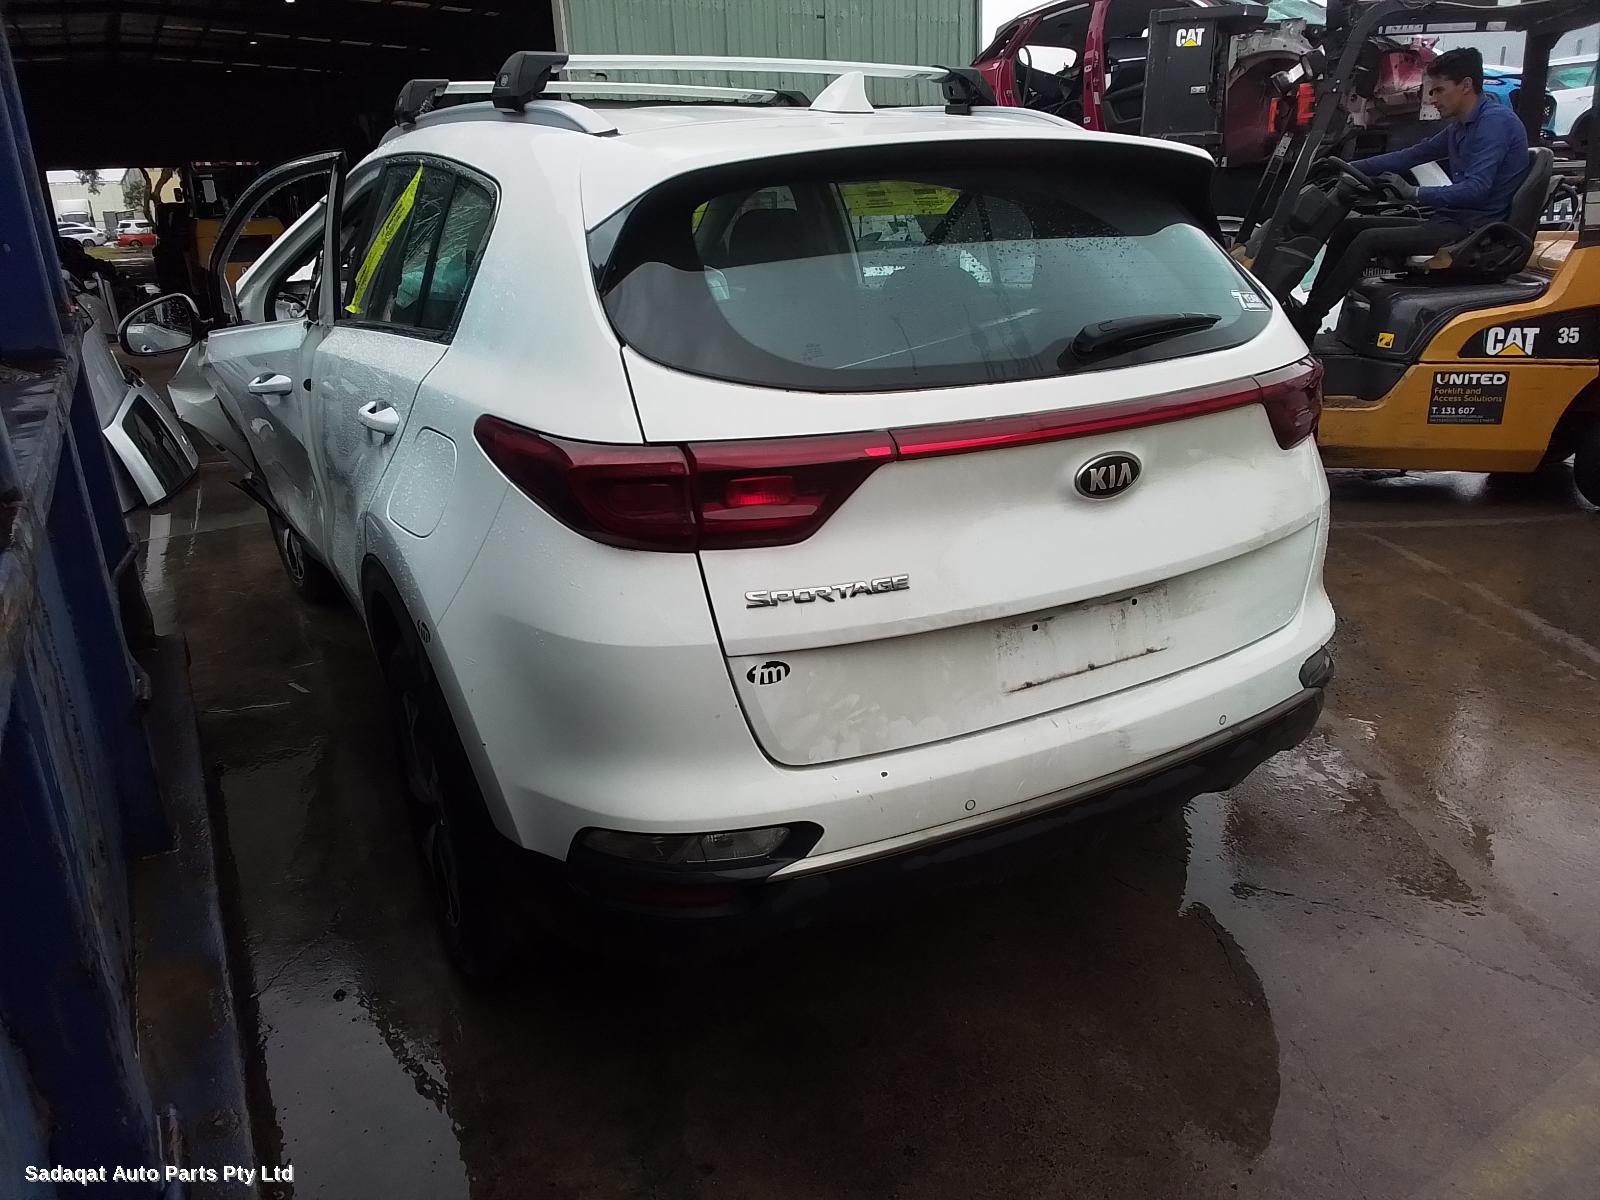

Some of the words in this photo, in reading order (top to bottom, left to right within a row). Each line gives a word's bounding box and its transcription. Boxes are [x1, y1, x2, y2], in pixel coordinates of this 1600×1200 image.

[1176, 28, 1205, 47] CAT
[1486, 327, 1540, 356] CAT
[1558, 327, 1580, 344] 35
[1436, 373, 1507, 385] UNITED
[1434, 387, 1464, 395] Forklift
[1465, 387, 1481, 395] and
[1463, 394, 1503, 403] Solutions
[1431, 406, 1439, 414] T.
[1441, 407, 1455, 415] 131
[1458, 406, 1475, 414] 607
[1089, 462, 1132, 492] KIA
[745, 574, 909, 609] SPORTAGE
